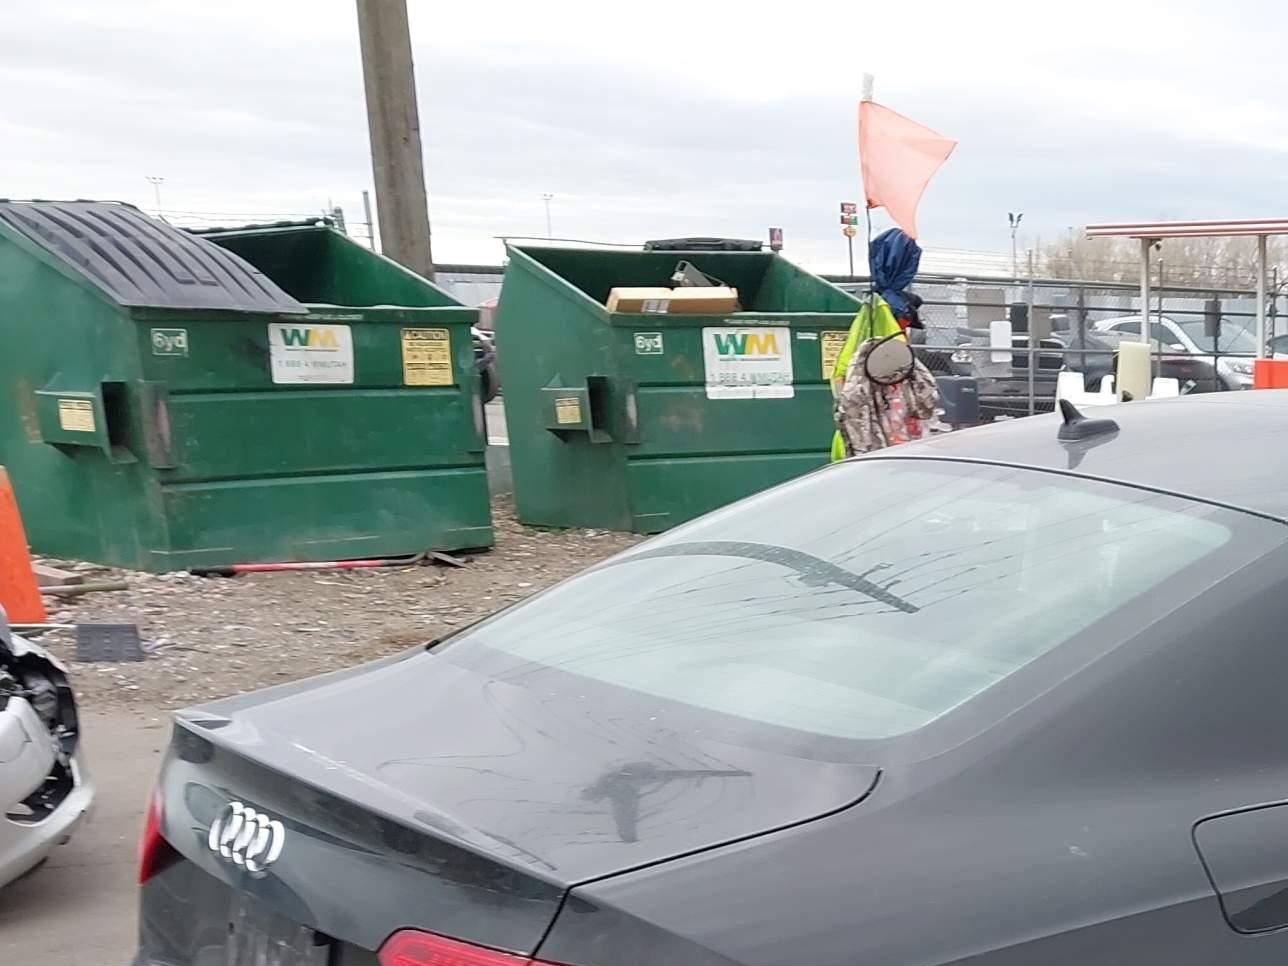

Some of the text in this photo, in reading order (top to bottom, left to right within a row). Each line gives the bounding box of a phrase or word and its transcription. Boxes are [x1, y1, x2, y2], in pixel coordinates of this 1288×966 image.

[153, 332, 185, 351] 6yd
[280, 328, 338, 347] WM
[713, 333, 779, 355] WM
